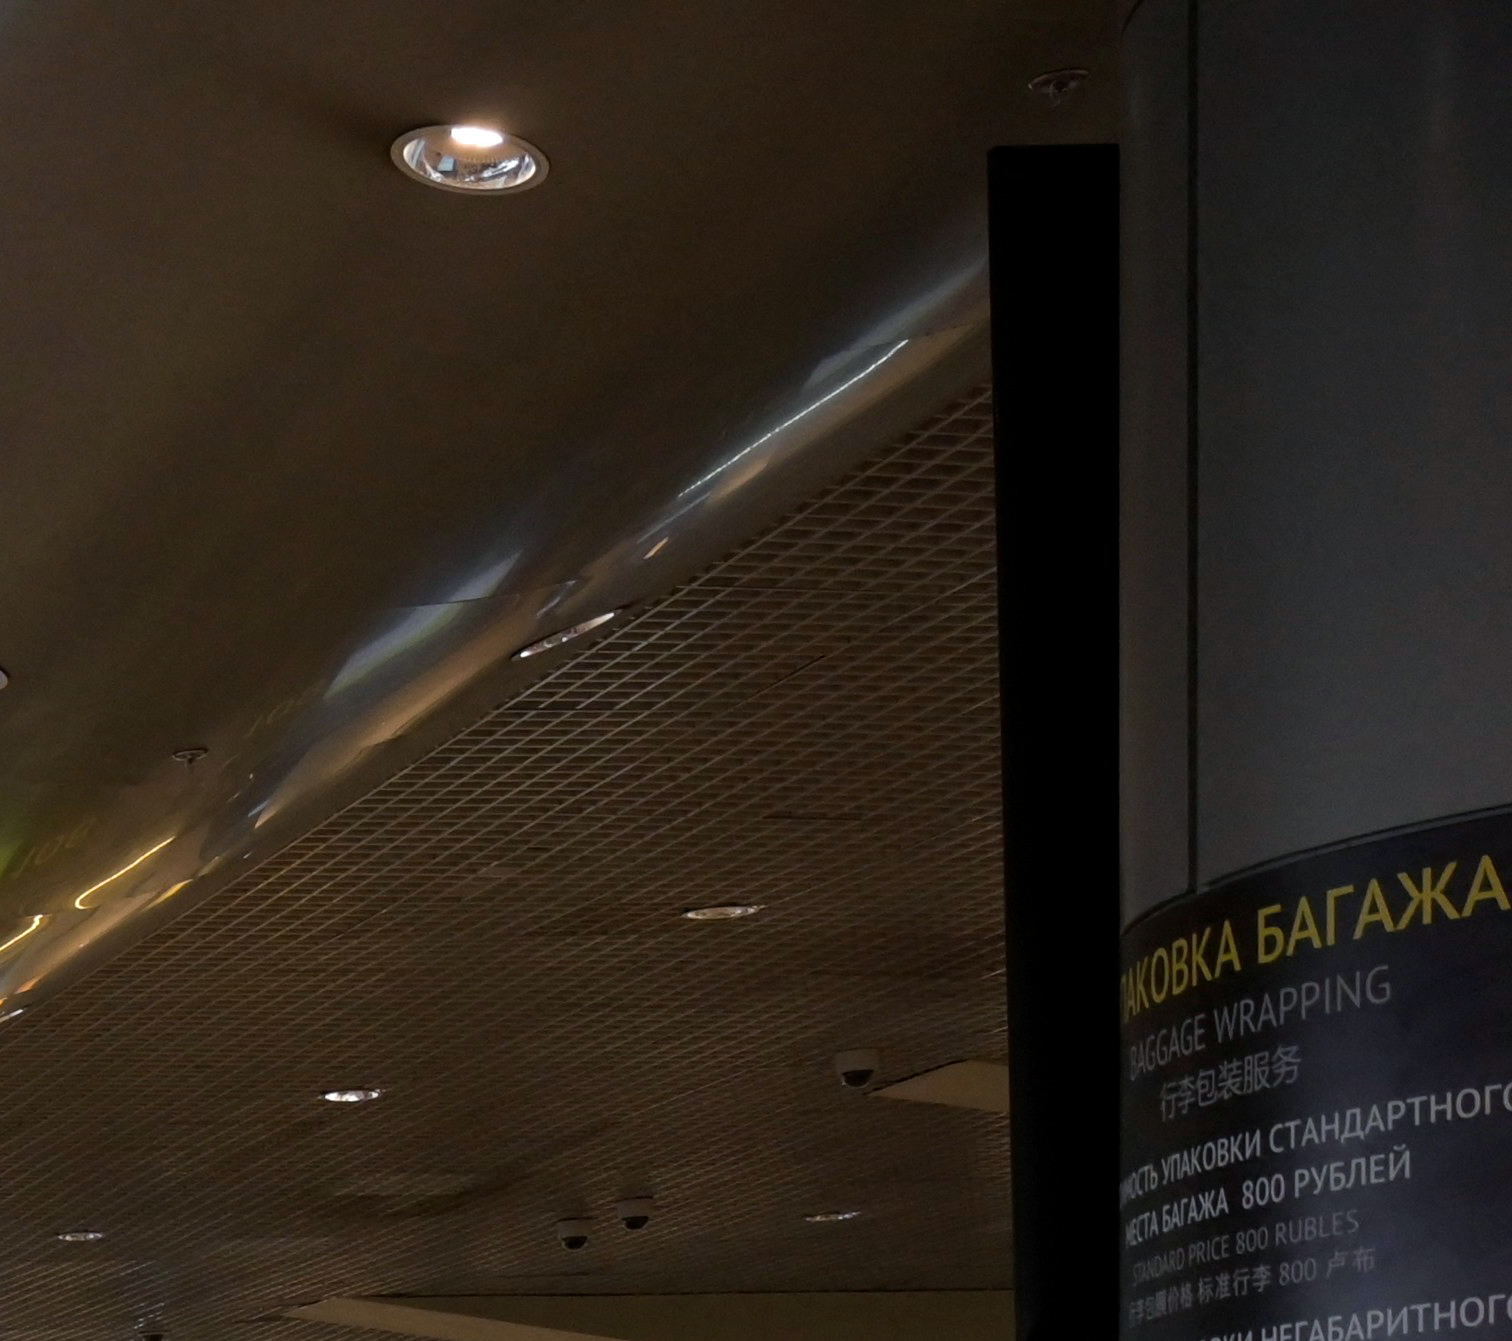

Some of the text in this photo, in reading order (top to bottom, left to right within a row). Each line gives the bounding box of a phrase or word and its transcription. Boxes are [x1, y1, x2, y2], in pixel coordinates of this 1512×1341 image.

[1257, 855, 1511, 964] БАГАЖА
[1130, 966, 1392, 1080] BAGGAGE WRAPPING
[1160, 1045, 1300, 1122] 行李包装服务
[1161, 1129, 1260, 1184] УПАКОВКИ
[1162, 1146, 1411, 1232] БАГАЖА 800 РУБЛЕЙ
[1133, 1211, 1360, 1286] STANDARD PRICE 800 RUBLES
[1196, 1259, 1317, 1303] 标准行李 800
